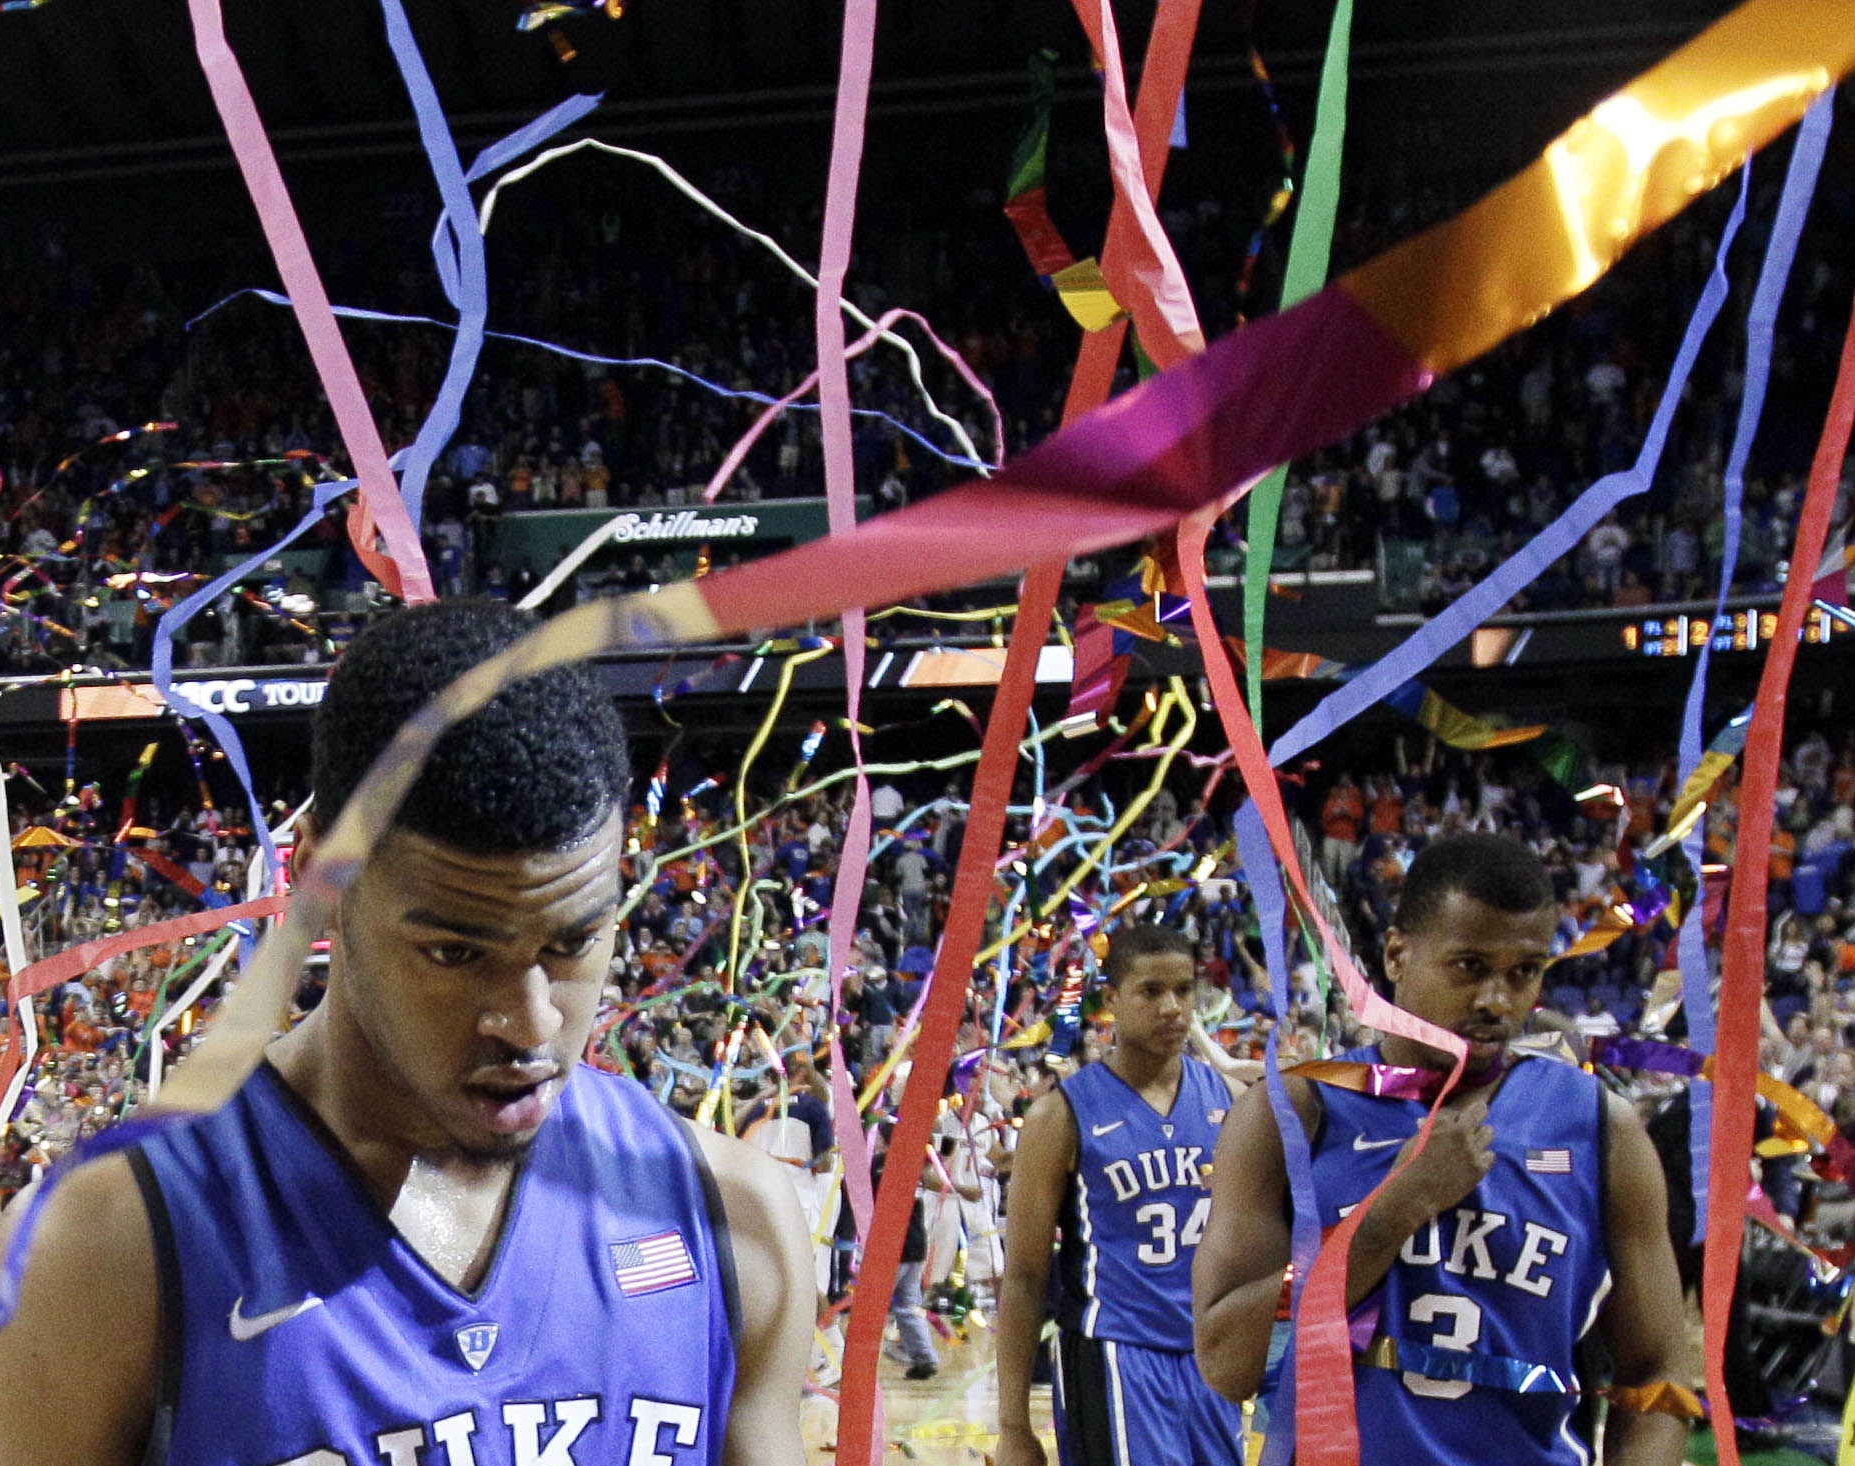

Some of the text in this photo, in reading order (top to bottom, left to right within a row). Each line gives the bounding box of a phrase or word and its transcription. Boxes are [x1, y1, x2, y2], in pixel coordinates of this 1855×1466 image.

[614, 511, 759, 542] Schillman's
[1102, 1145, 1213, 1203] DUK
[1135, 1196, 1213, 1265] 34
[1402, 1293, 1482, 1400] 3
